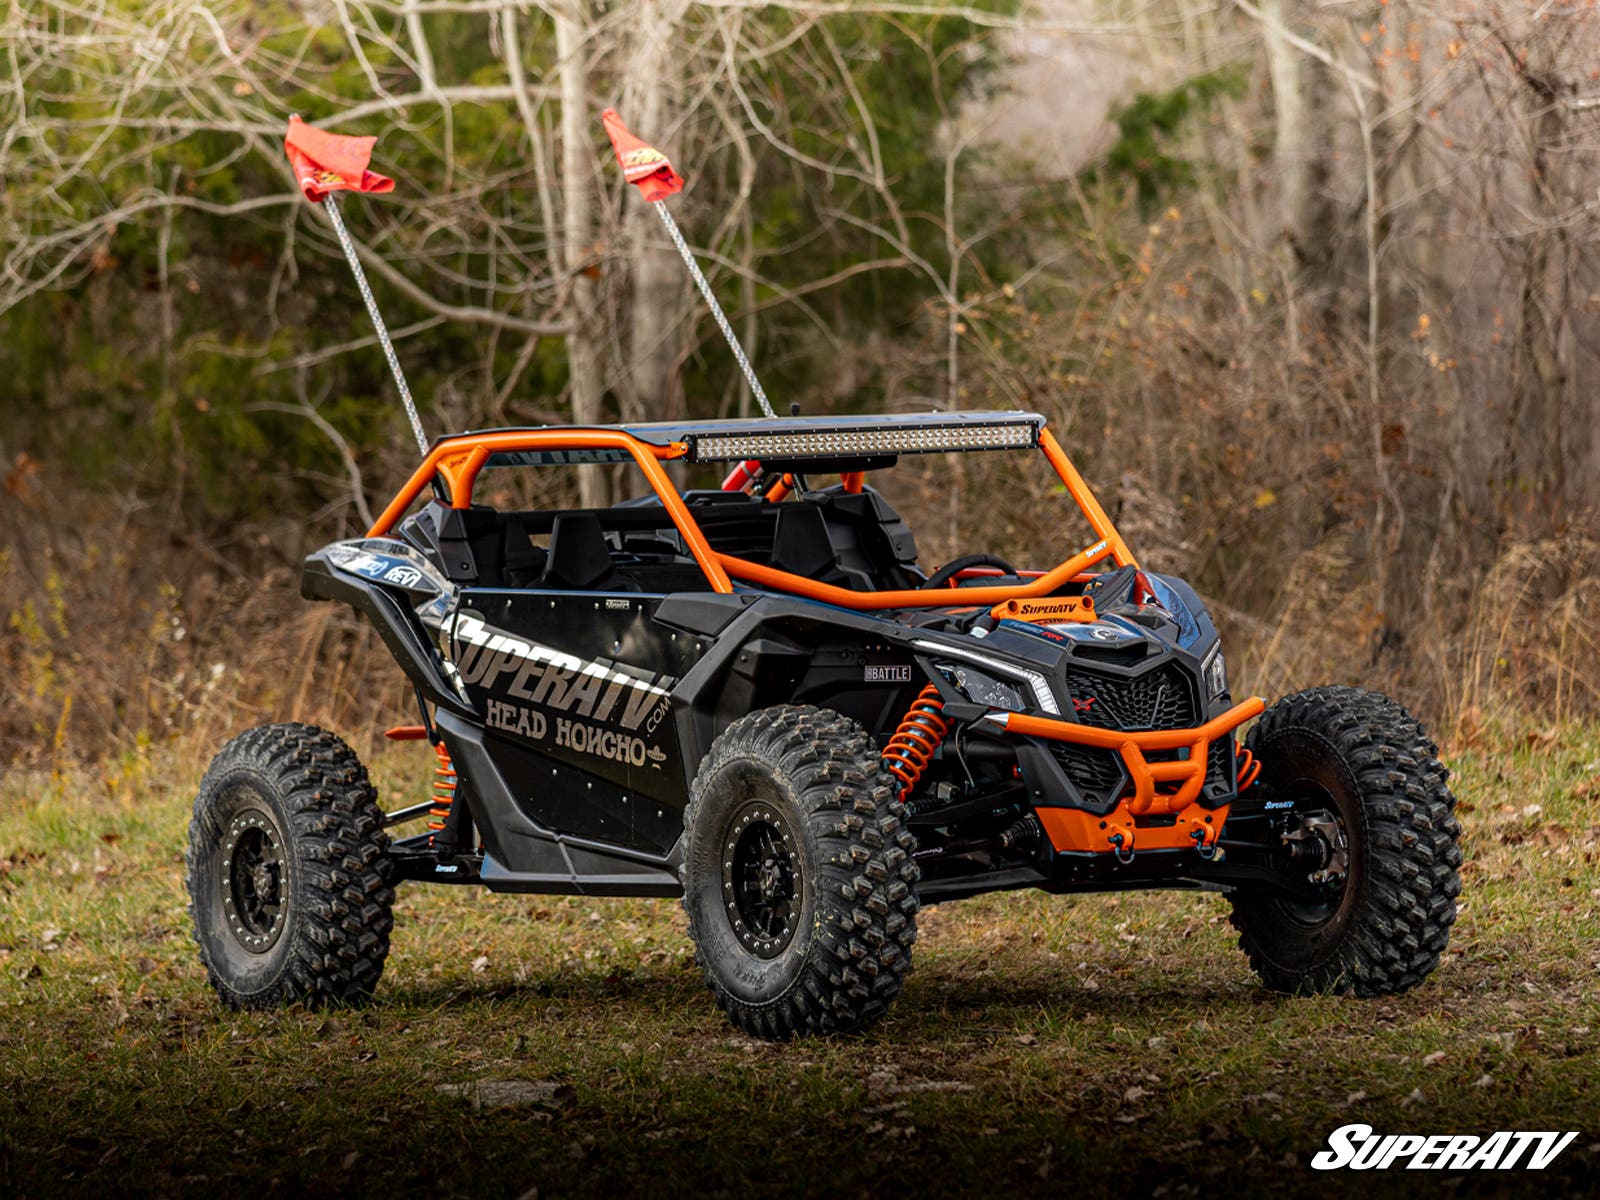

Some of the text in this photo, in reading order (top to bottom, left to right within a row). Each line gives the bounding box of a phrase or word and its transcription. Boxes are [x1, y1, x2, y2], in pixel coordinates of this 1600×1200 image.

[1021, 604, 1076, 614] SUPERATV
[441, 607, 676, 731] SUPERATV
[872, 667, 908, 680] BATTLE
[485, 699, 646, 767] HEAD HONCHO
